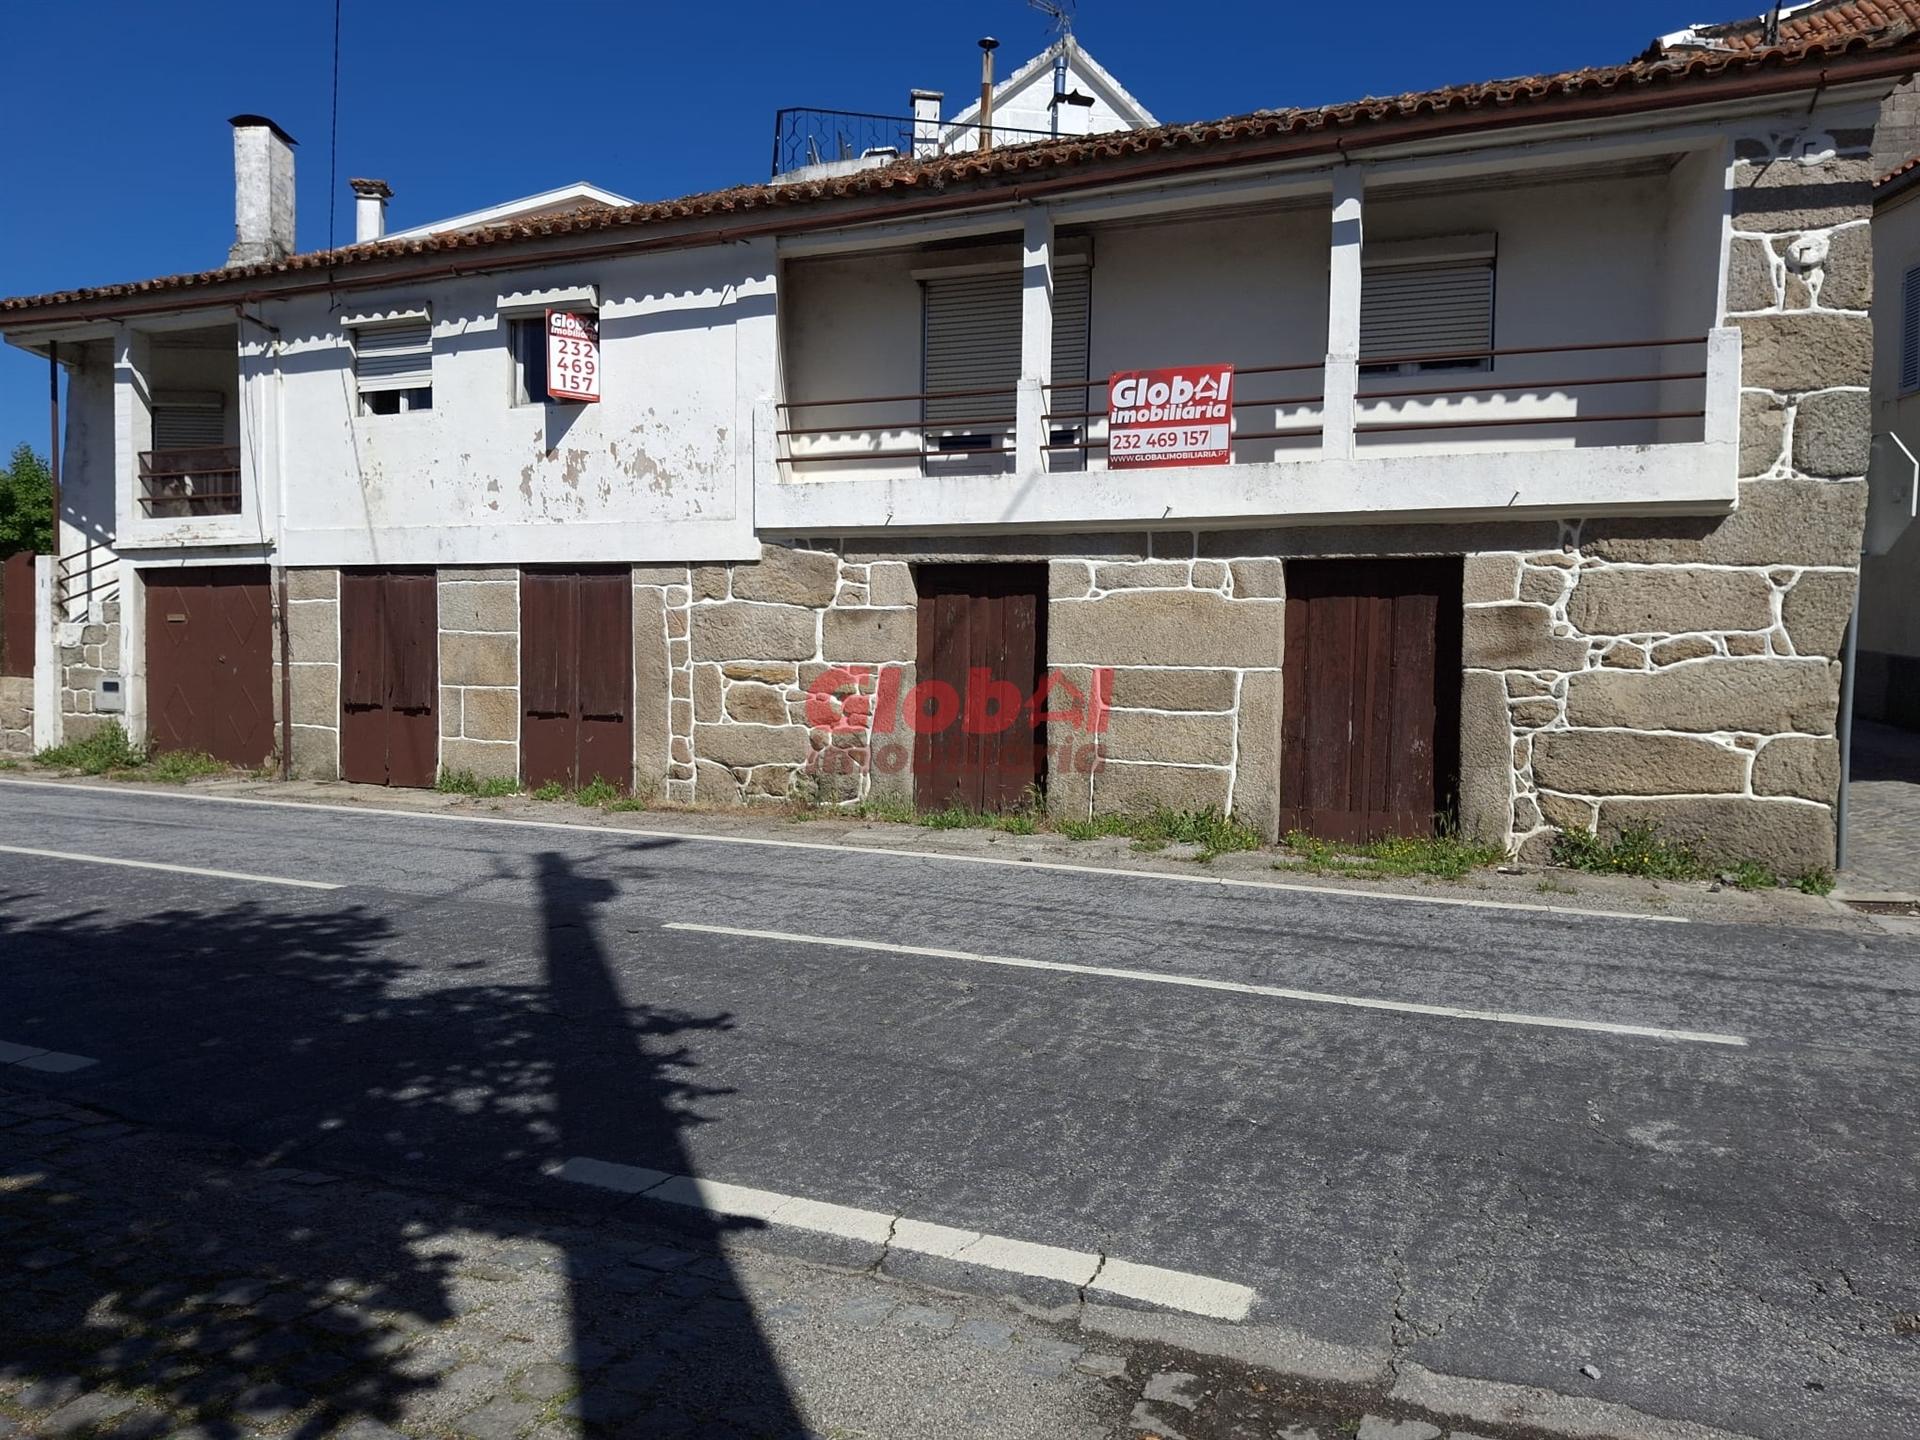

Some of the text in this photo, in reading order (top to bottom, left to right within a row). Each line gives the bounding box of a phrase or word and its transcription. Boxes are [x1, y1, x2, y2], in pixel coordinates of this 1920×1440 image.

[558, 340, 593, 358] 232
[557, 357, 595, 375] 469
[560, 374, 592, 391] 157
[1110, 401, 1227, 424] imobiliária
[1113, 430, 1209, 450] 232 469 157
